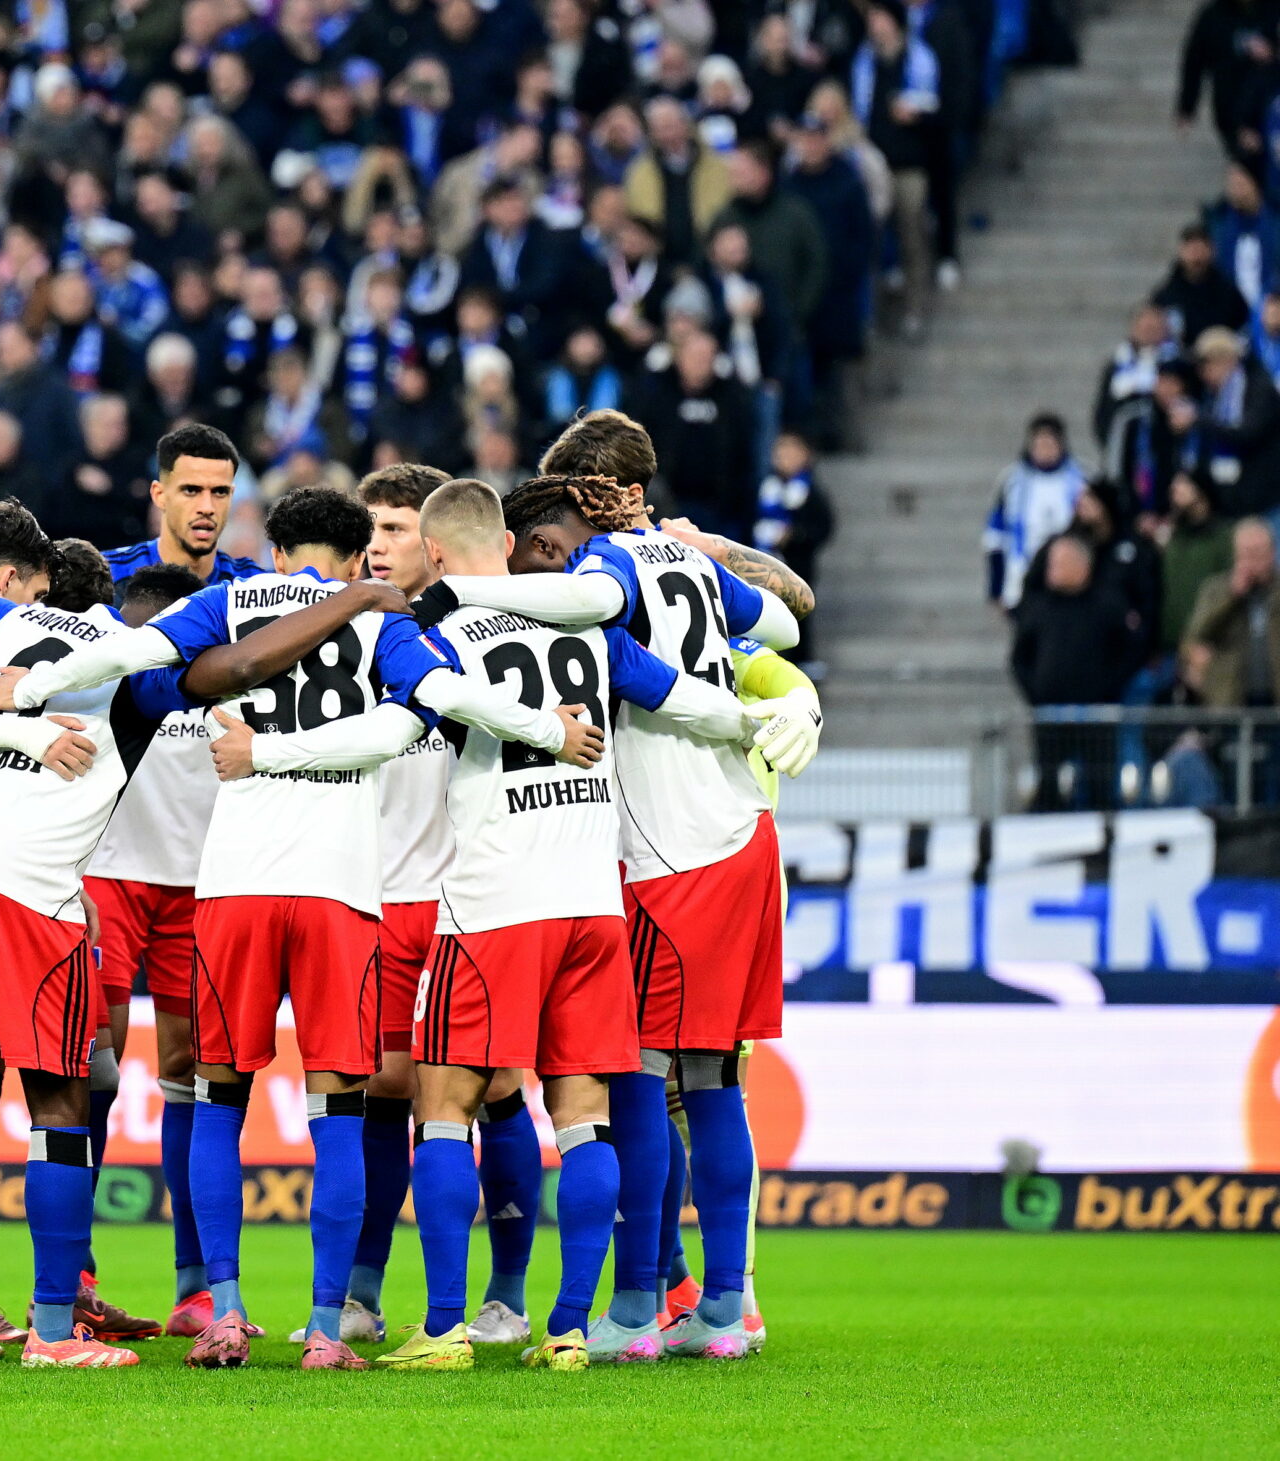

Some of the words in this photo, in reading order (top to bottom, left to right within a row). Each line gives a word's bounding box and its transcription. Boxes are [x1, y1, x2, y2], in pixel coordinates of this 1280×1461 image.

[482, 636, 606, 774] 28
[505, 777, 612, 815] MUHEIM
[756, 1172, 950, 1227] trade
